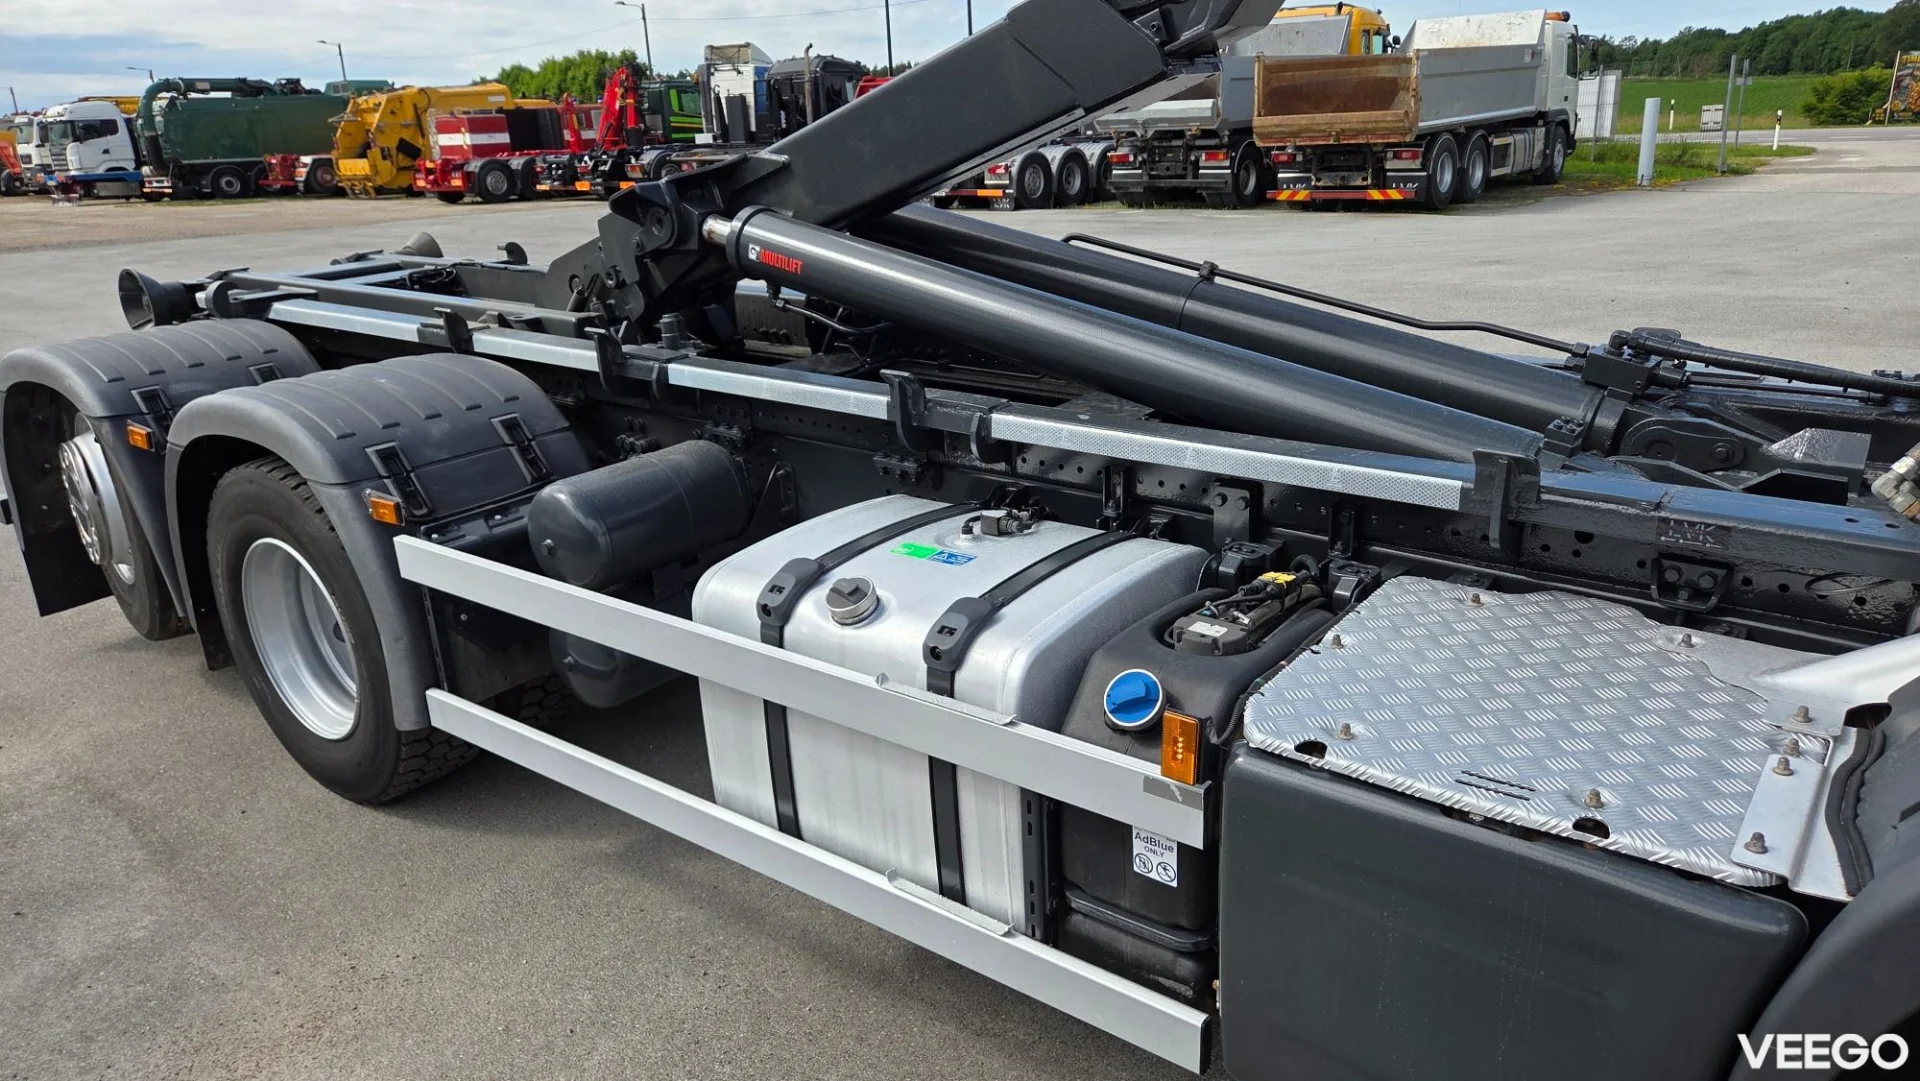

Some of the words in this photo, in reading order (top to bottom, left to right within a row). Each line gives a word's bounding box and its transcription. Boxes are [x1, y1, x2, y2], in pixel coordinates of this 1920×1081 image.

[760, 248, 803, 275] MULTILIFT
[1668, 519, 1716, 543] LVK
[1134, 831, 1174, 853] AdBlue
[1144, 845, 1165, 858] ONLY
